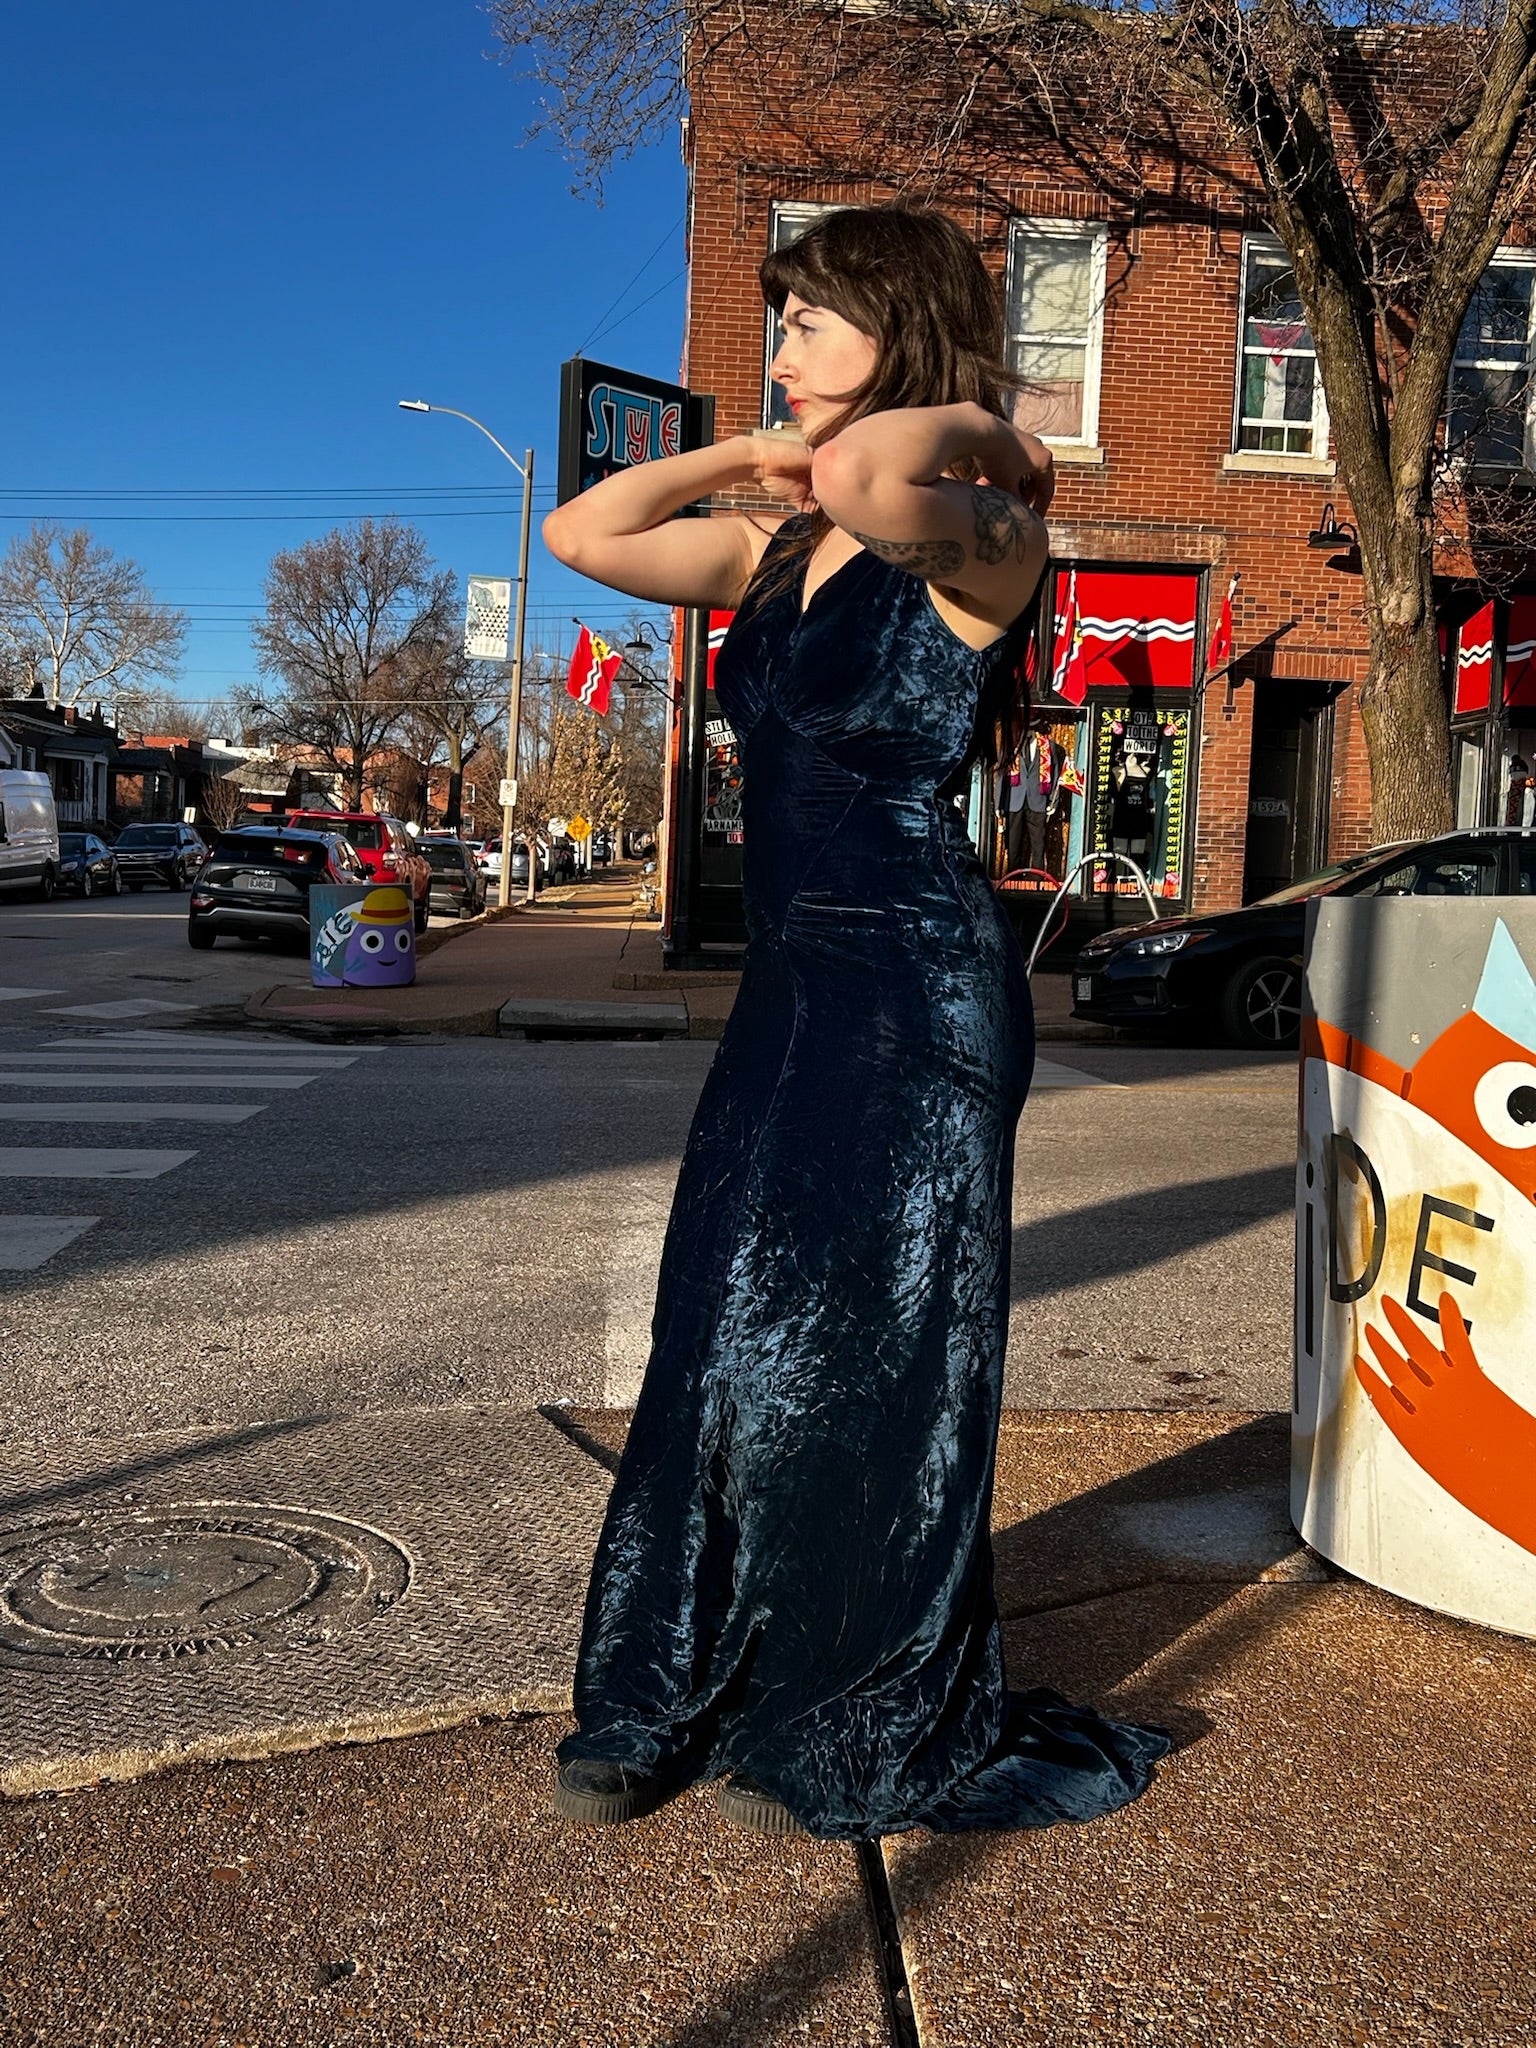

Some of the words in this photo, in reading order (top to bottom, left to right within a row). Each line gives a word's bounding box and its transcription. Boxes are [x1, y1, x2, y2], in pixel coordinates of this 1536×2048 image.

[705, 722, 721, 732] STL
[1128, 726, 1139, 737] TO
[1142, 727, 1158, 738] THE
[1125, 740, 1156, 751] WORLD
